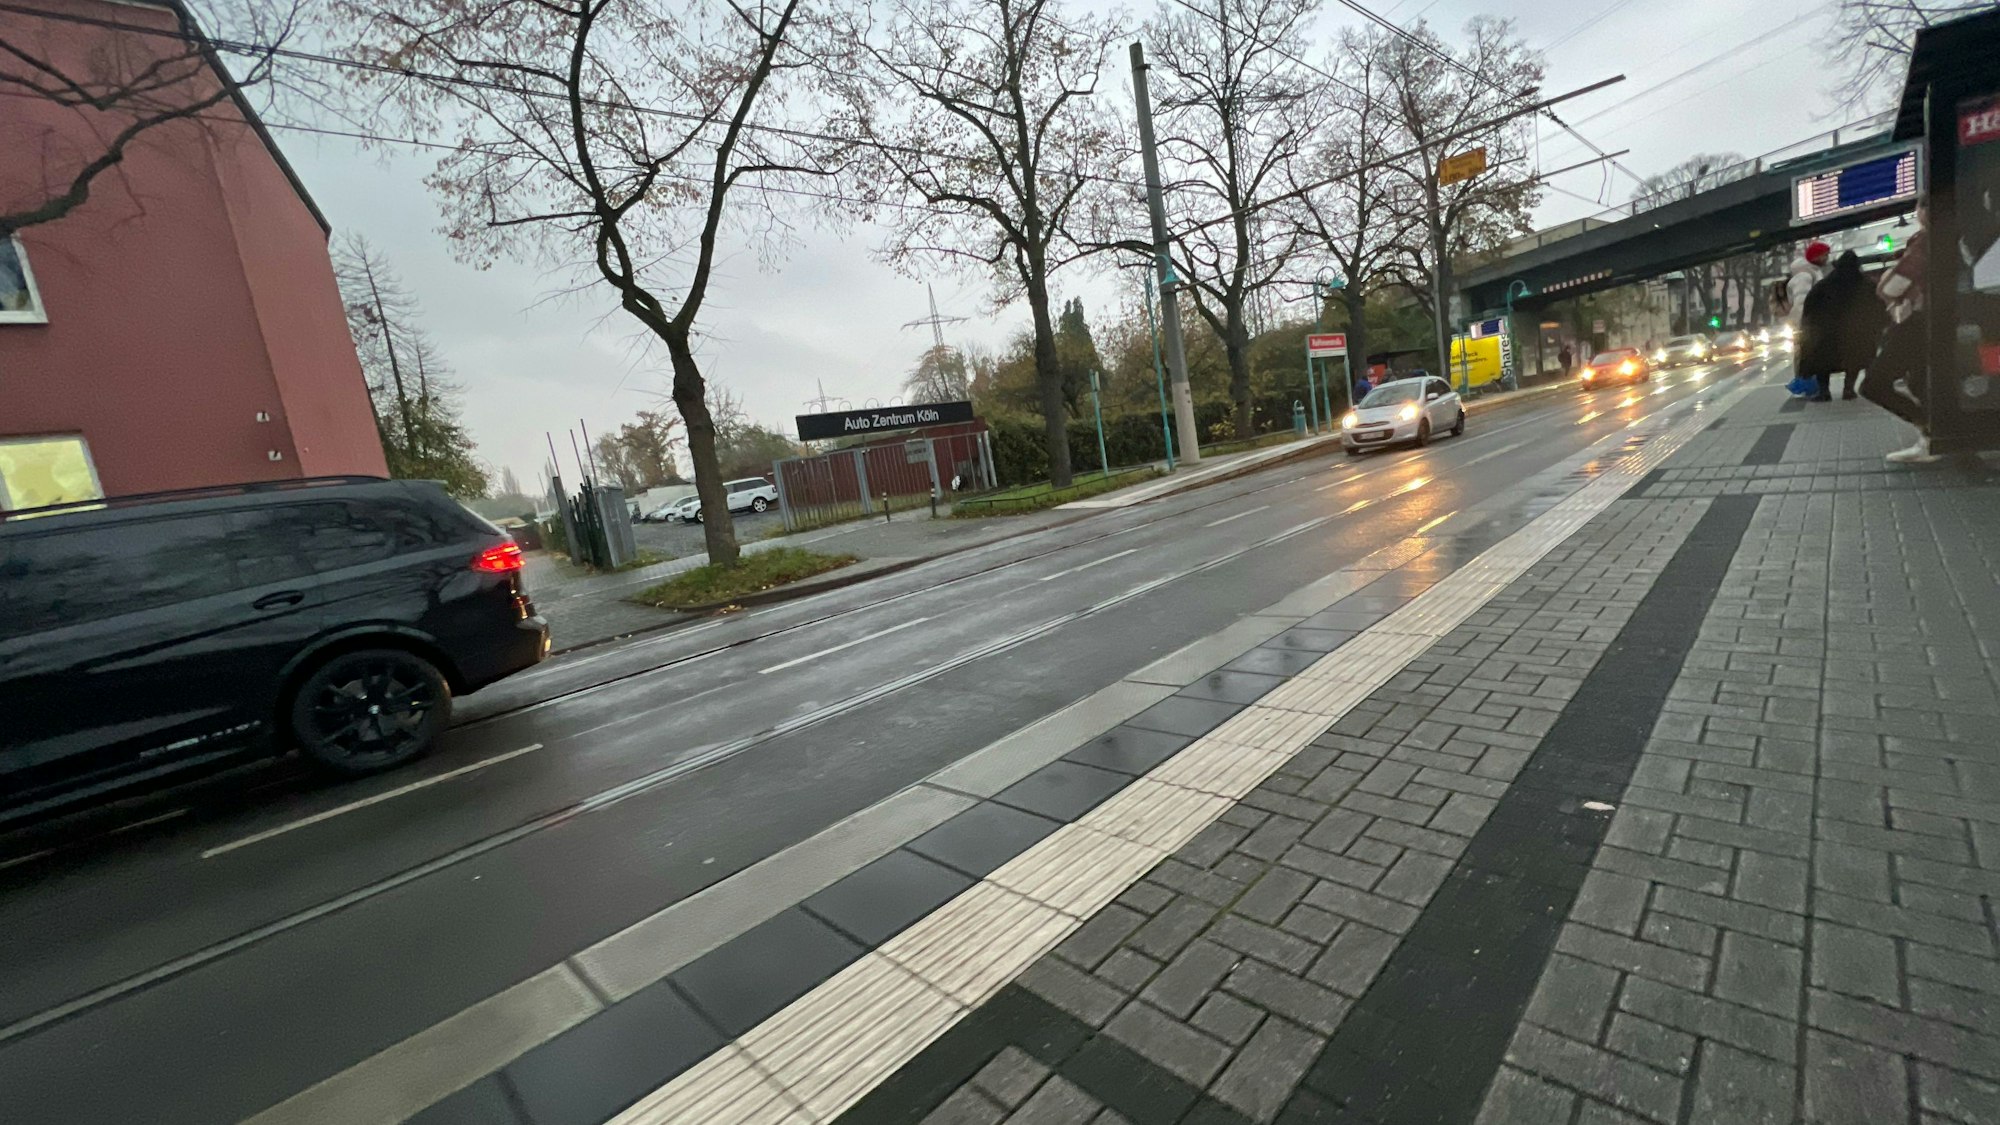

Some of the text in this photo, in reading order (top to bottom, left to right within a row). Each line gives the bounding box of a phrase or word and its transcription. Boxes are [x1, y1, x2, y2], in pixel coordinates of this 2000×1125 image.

[844, 409, 940, 431] Auto Zentrum Köln
